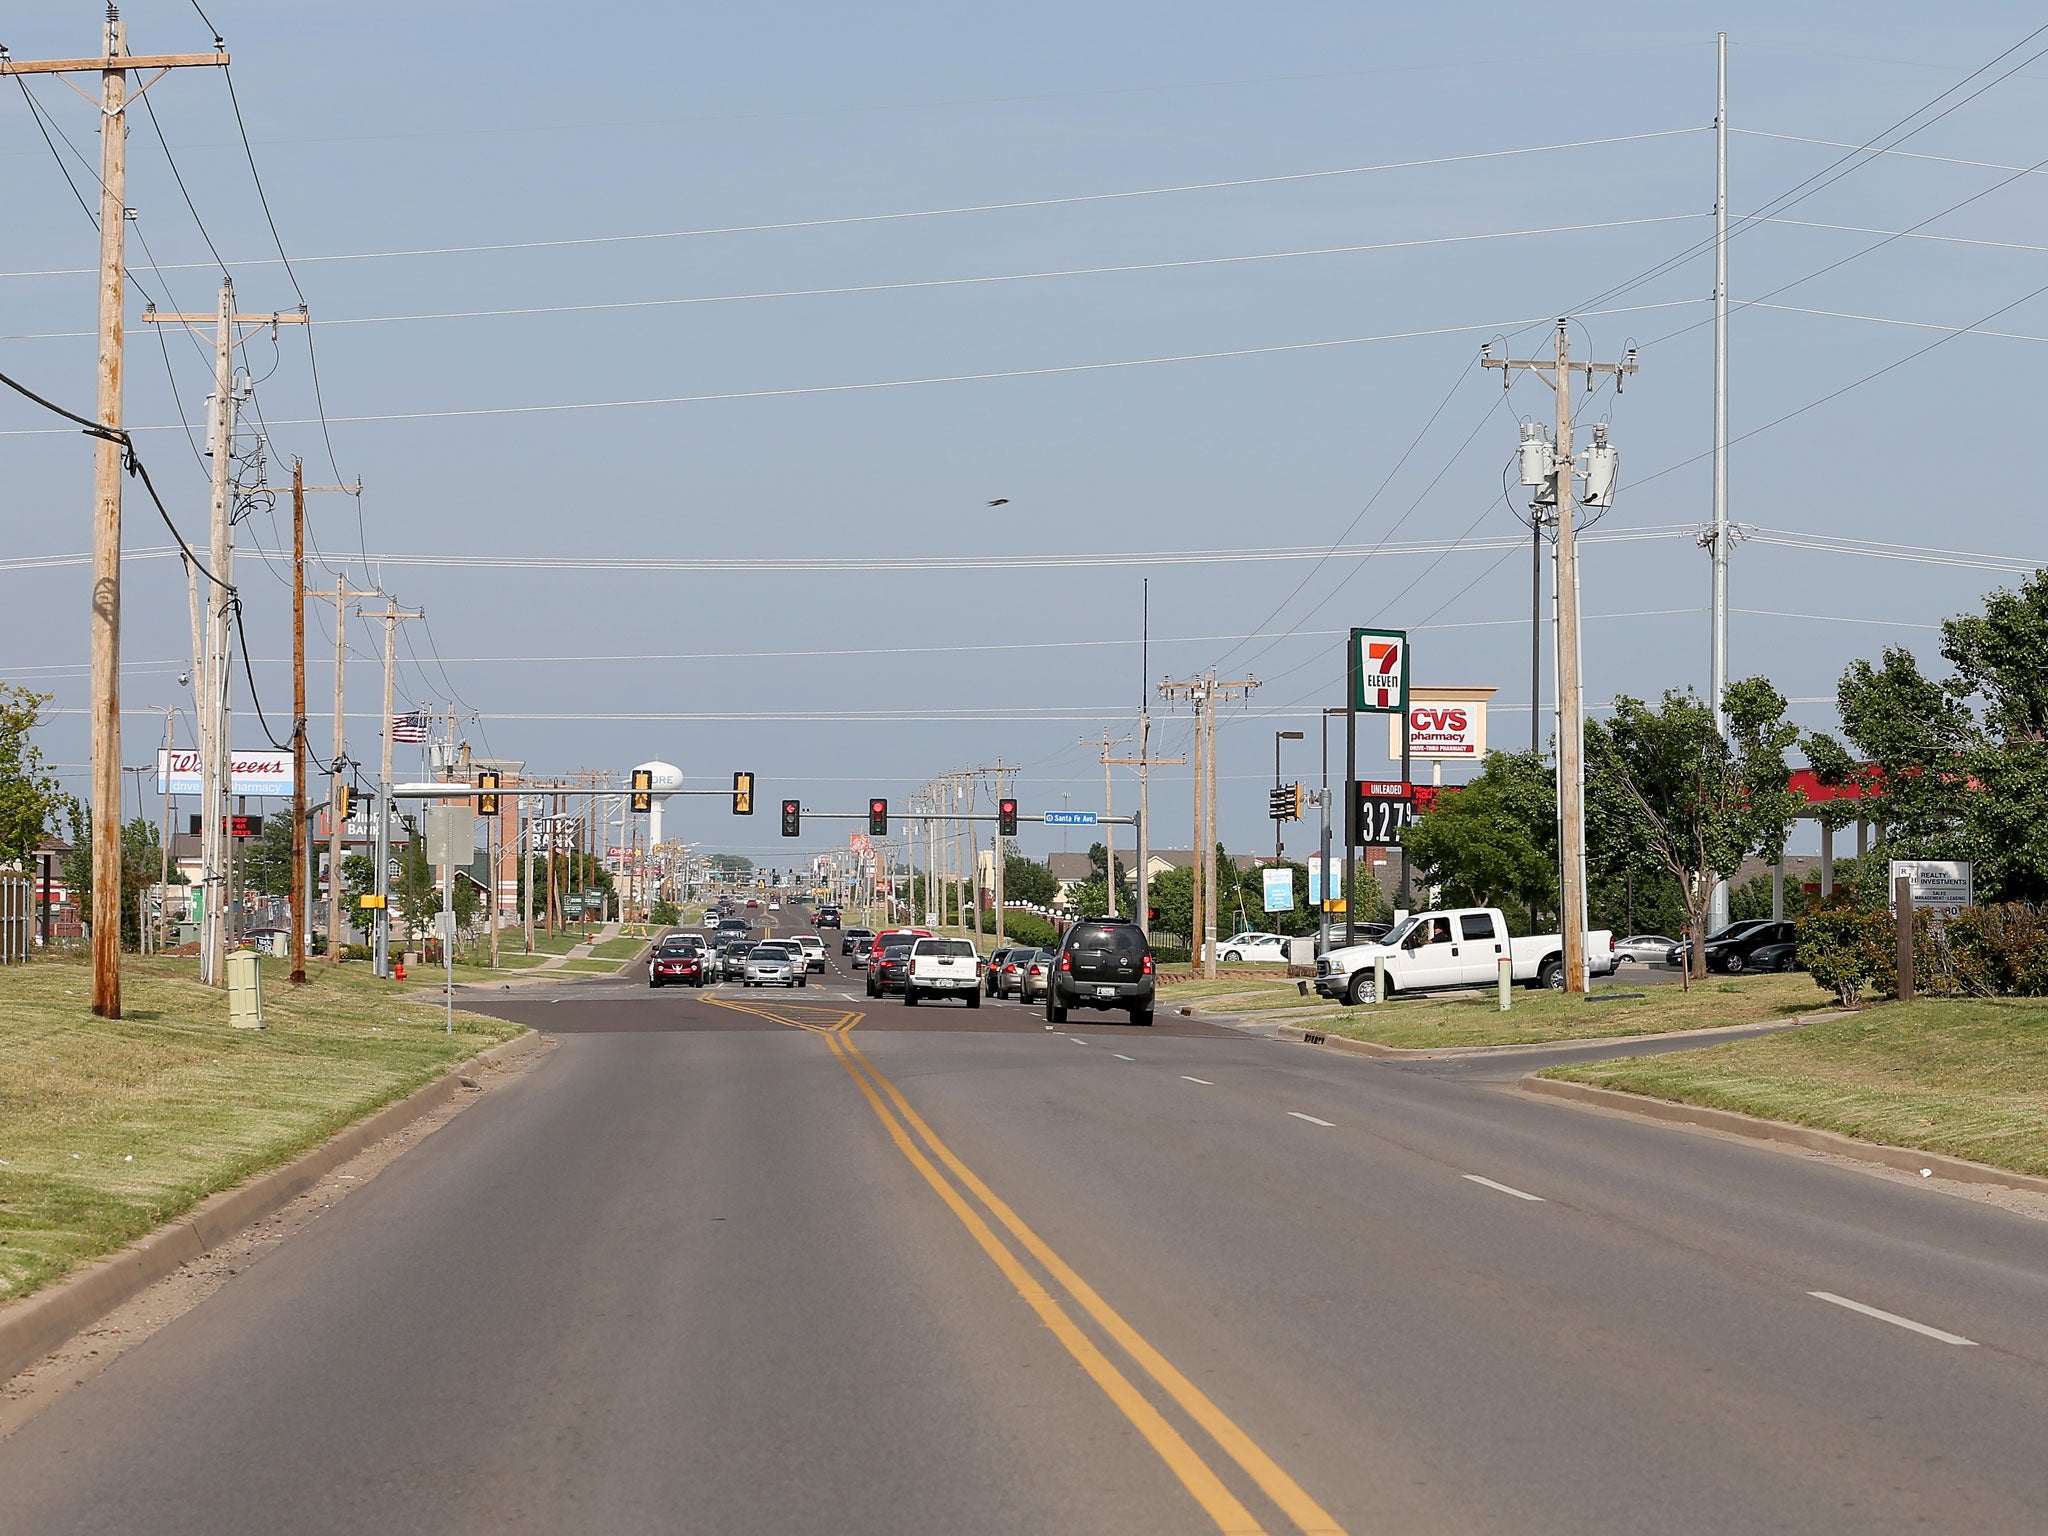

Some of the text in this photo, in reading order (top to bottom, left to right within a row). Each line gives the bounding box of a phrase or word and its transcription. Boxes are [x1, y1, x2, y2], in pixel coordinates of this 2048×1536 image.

[1369, 643, 1398, 707] 7
[1410, 708, 1467, 731] CVS
[1411, 732, 1465, 742] pharmacy
[652, 775, 674, 784] ORE
[1370, 784, 1402, 795] UNLEADED
[1054, 814, 1072, 822] Santa
[348, 823, 380, 835] BANK
